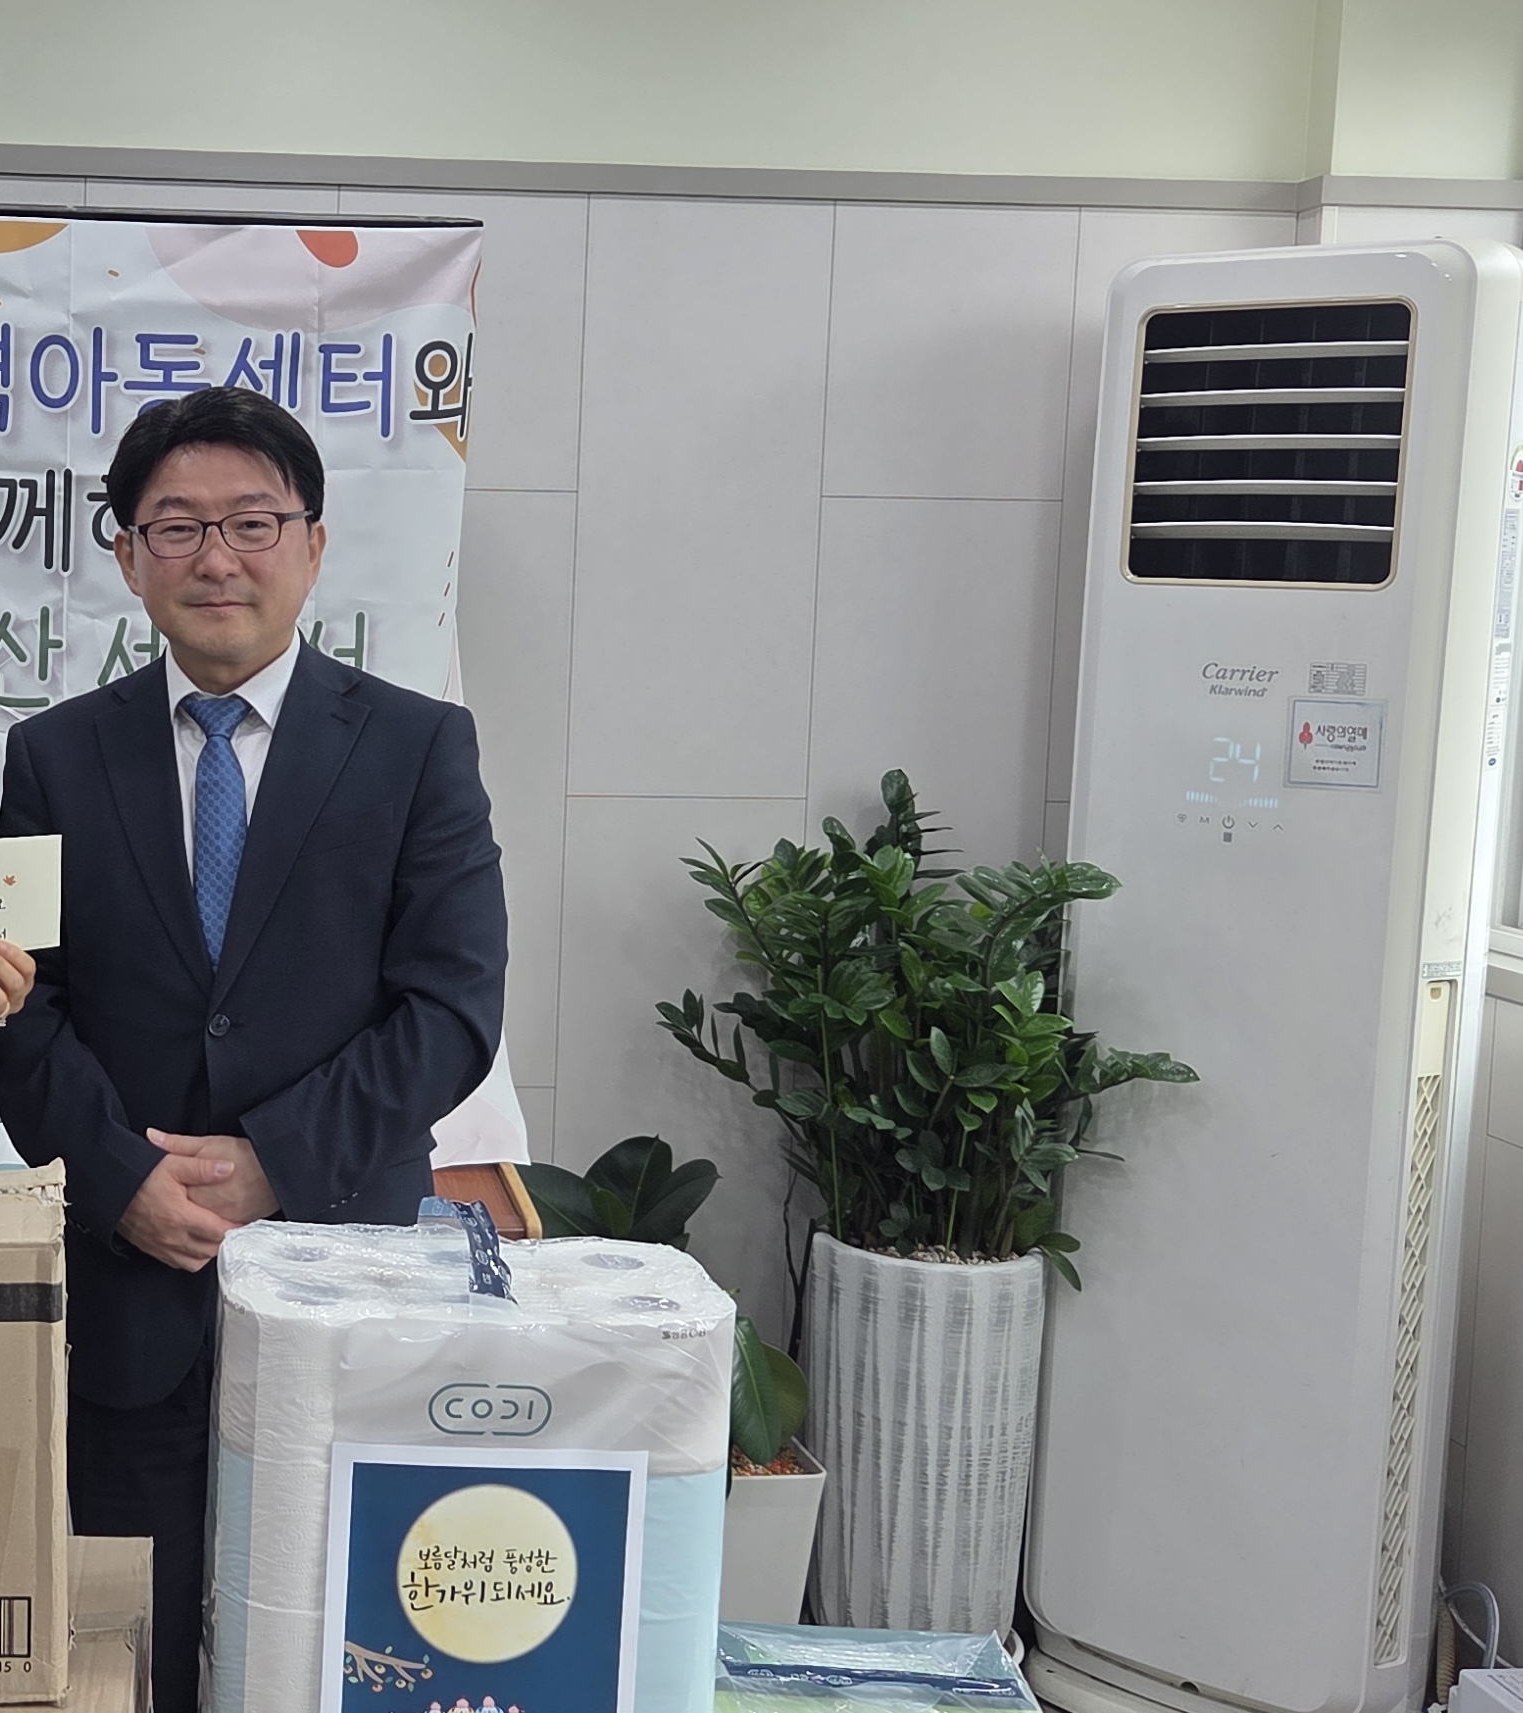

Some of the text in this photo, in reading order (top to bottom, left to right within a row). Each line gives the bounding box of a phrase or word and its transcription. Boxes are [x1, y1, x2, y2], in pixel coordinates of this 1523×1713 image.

[1202, 662, 1279, 682] Carrier
[1315, 725, 1367, 743] 사랑의열매
[1210, 737, 1261, 783] 24
[418, 1546, 558, 1574] 보름달처럼 풍성한
[23, 1661, 32, 1673] 0
